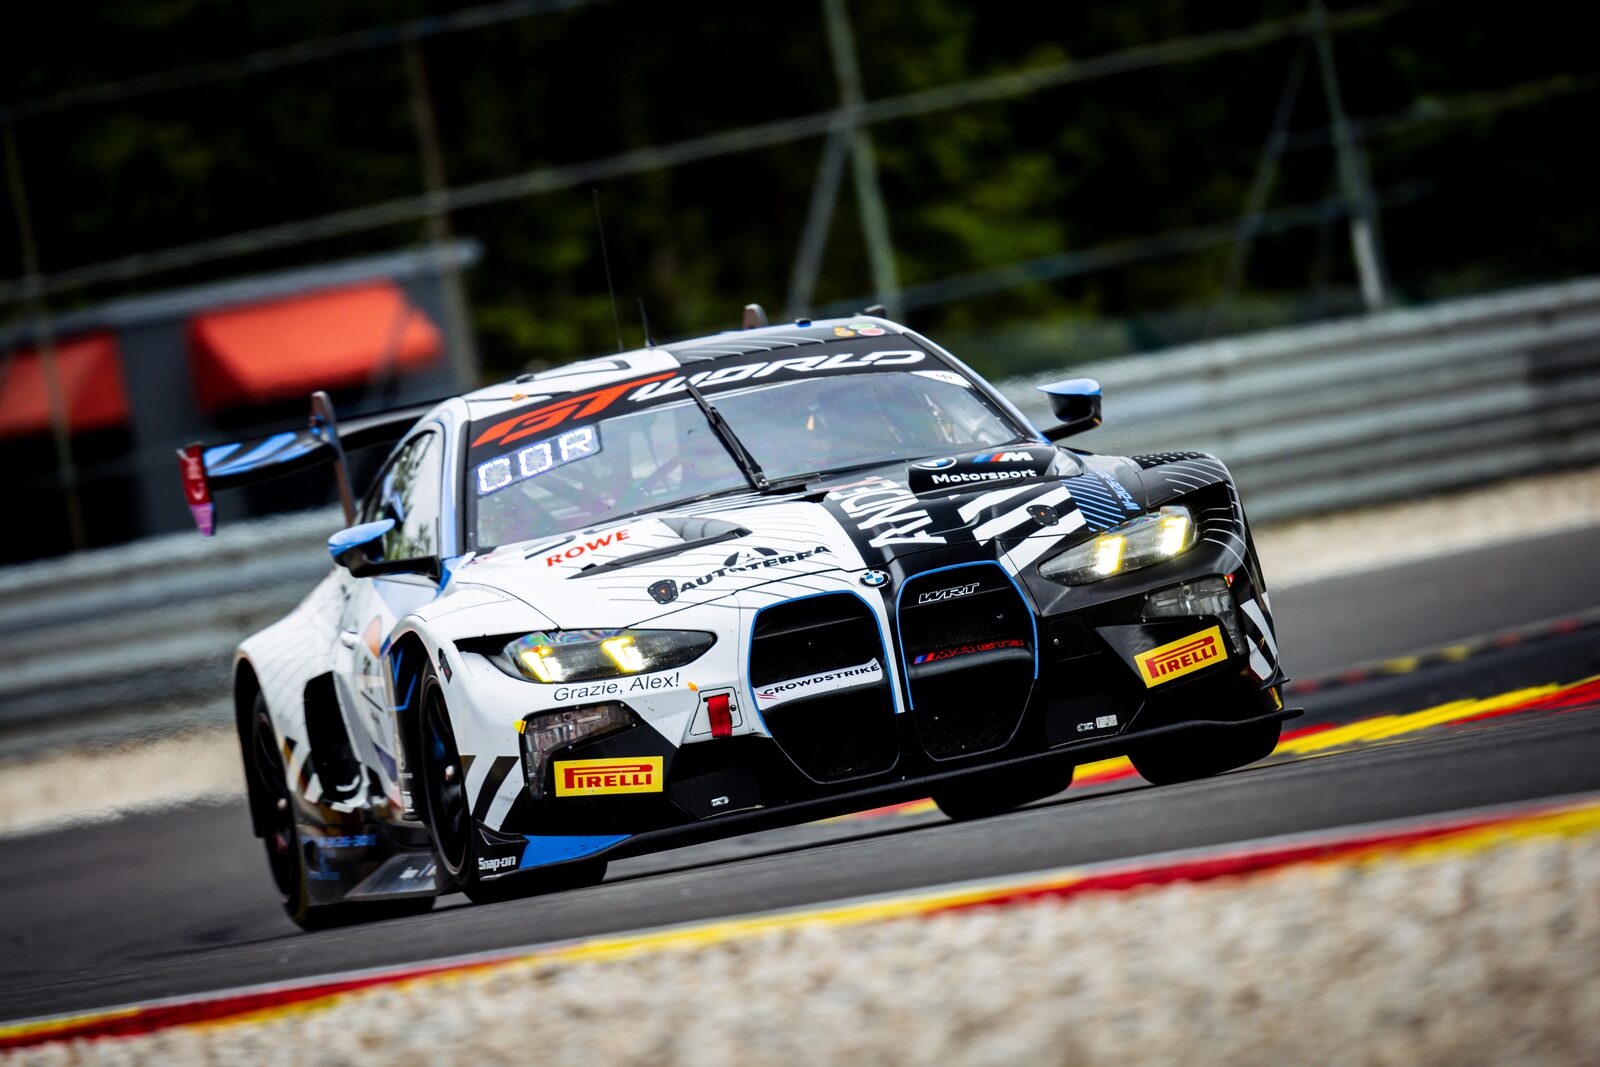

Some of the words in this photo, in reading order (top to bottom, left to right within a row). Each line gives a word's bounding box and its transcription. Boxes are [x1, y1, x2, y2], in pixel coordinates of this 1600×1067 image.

[628, 350, 926, 402] WORLD
[477, 427, 592, 492] COR
[931, 468, 1037, 484] Motorsport
[545, 529, 630, 567] ROWE
[918, 582, 980, 605] WRT
[1145, 635, 1218, 679] PIRELLI
[553, 681, 623, 702] Grazie,
[629, 671, 680, 691] Alex!
[763, 662, 880, 696] CROWDSTRIKE
[563, 763, 653, 789] PIRELLI
[477, 855, 517, 872] Snap-on
